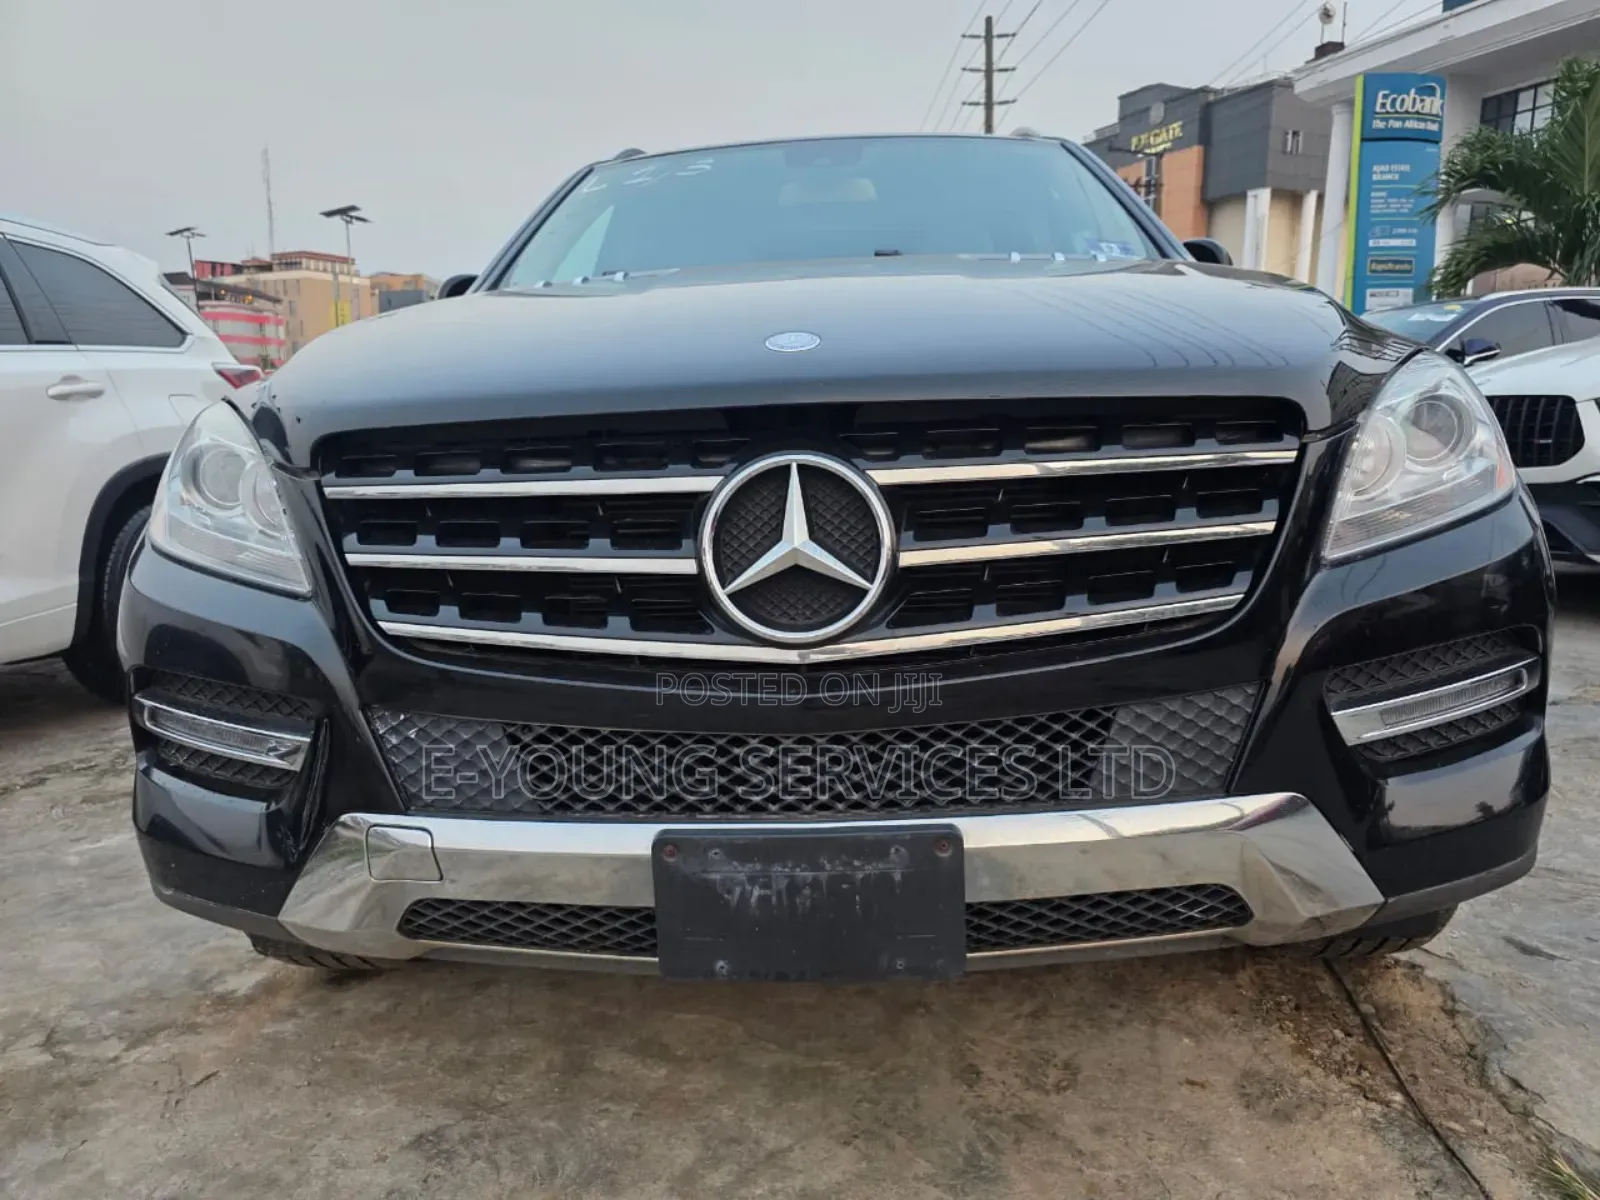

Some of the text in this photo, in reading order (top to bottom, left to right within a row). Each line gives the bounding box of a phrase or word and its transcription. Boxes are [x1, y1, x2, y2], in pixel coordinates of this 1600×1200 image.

[1375, 83, 1444, 115] Ecobank
[1372, 119, 1387, 129] The
[1387, 119, 1403, 129] Pan
